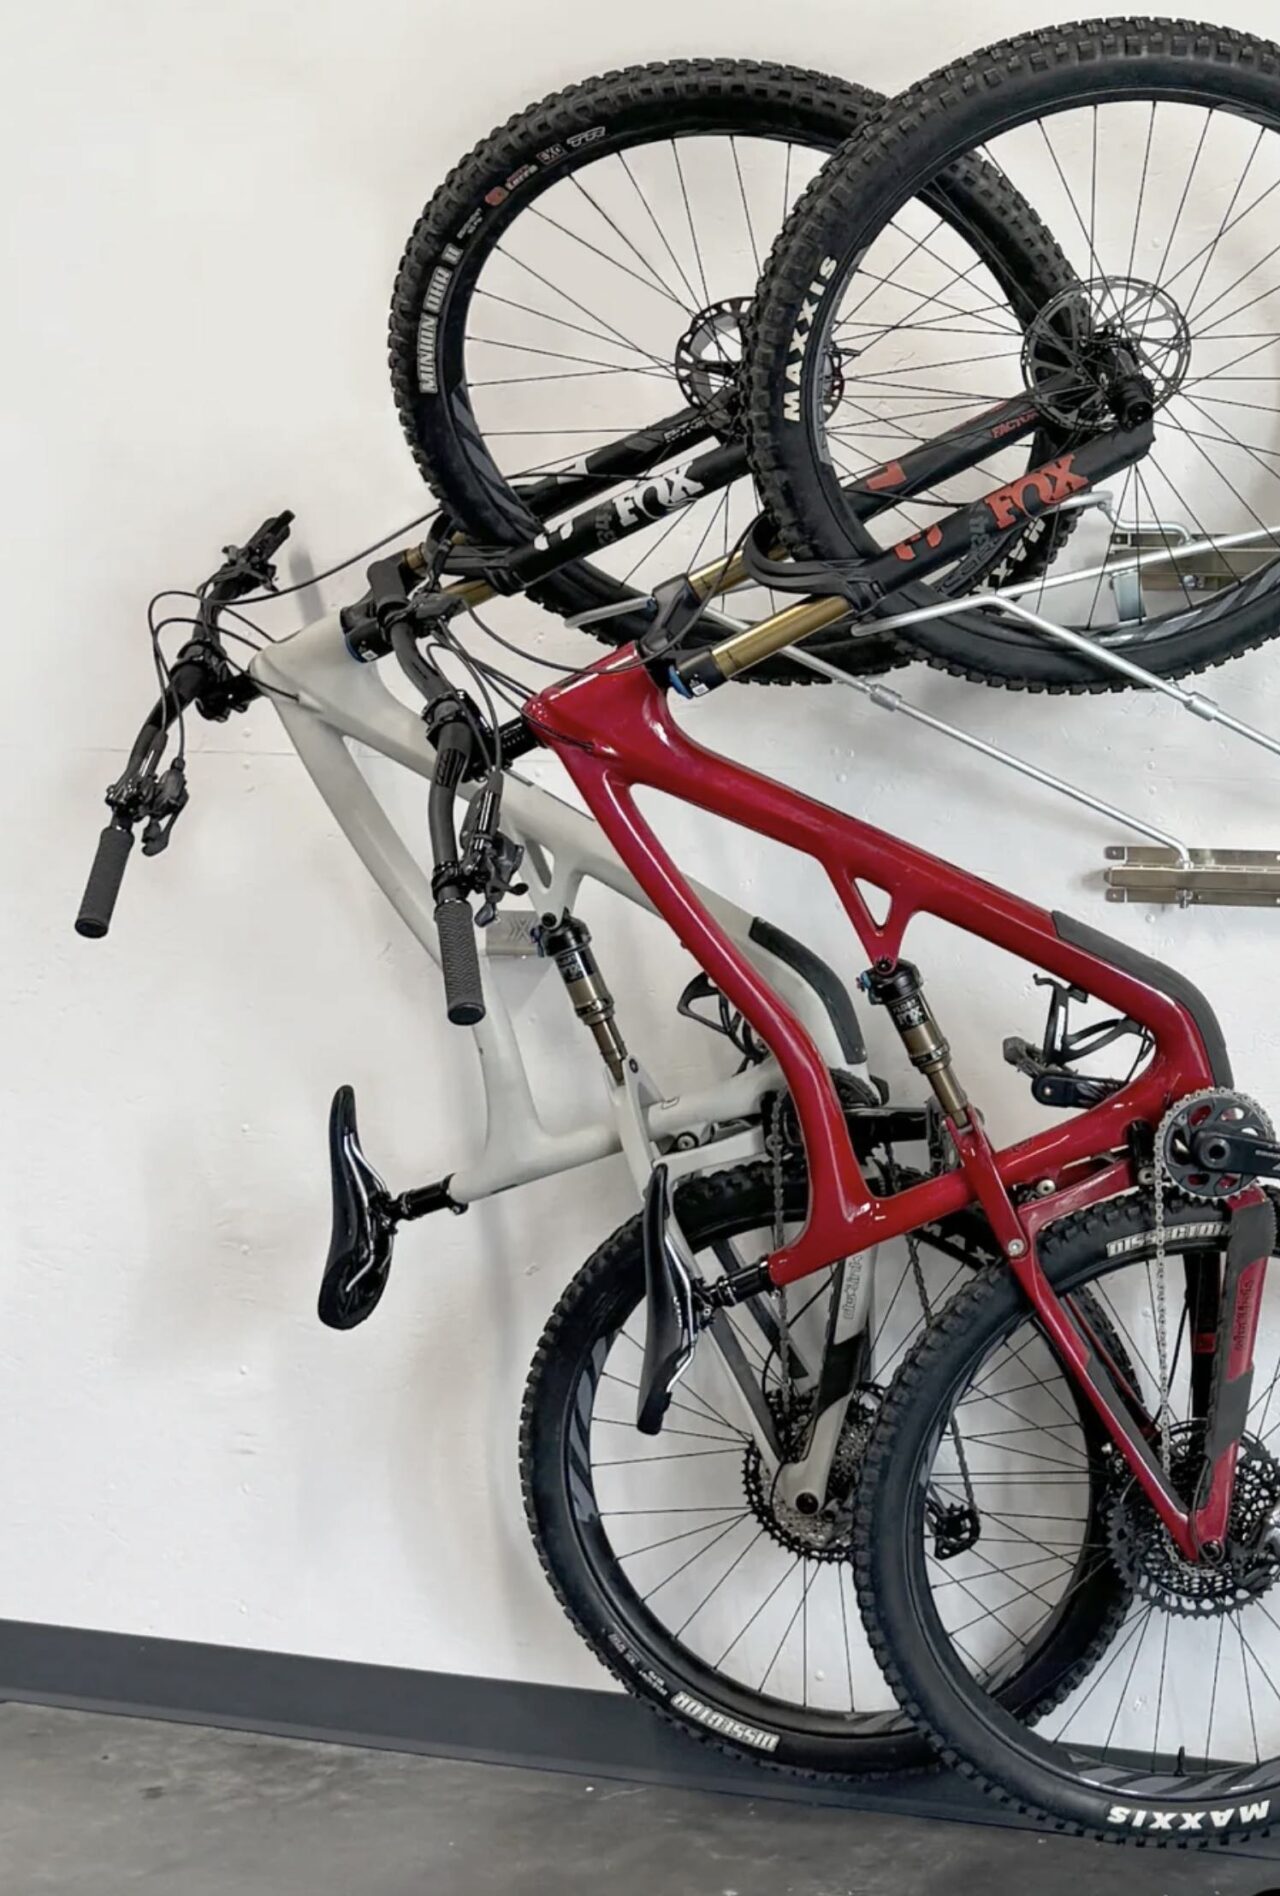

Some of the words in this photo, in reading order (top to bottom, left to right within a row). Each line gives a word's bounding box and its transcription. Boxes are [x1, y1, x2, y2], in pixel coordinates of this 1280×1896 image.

[783, 256, 838, 422] MAXXIS
[990, 408, 1040, 439] FACTOR
[612, 460, 704, 527] FOX
[984, 453, 1089, 529] FOX
[969, 516, 1046, 595] MAXX
[922, 1223, 997, 1267] MAX
[670, 1691, 781, 1752] DISSECTOR
[1107, 1800, 1271, 1831] MAXXIS
